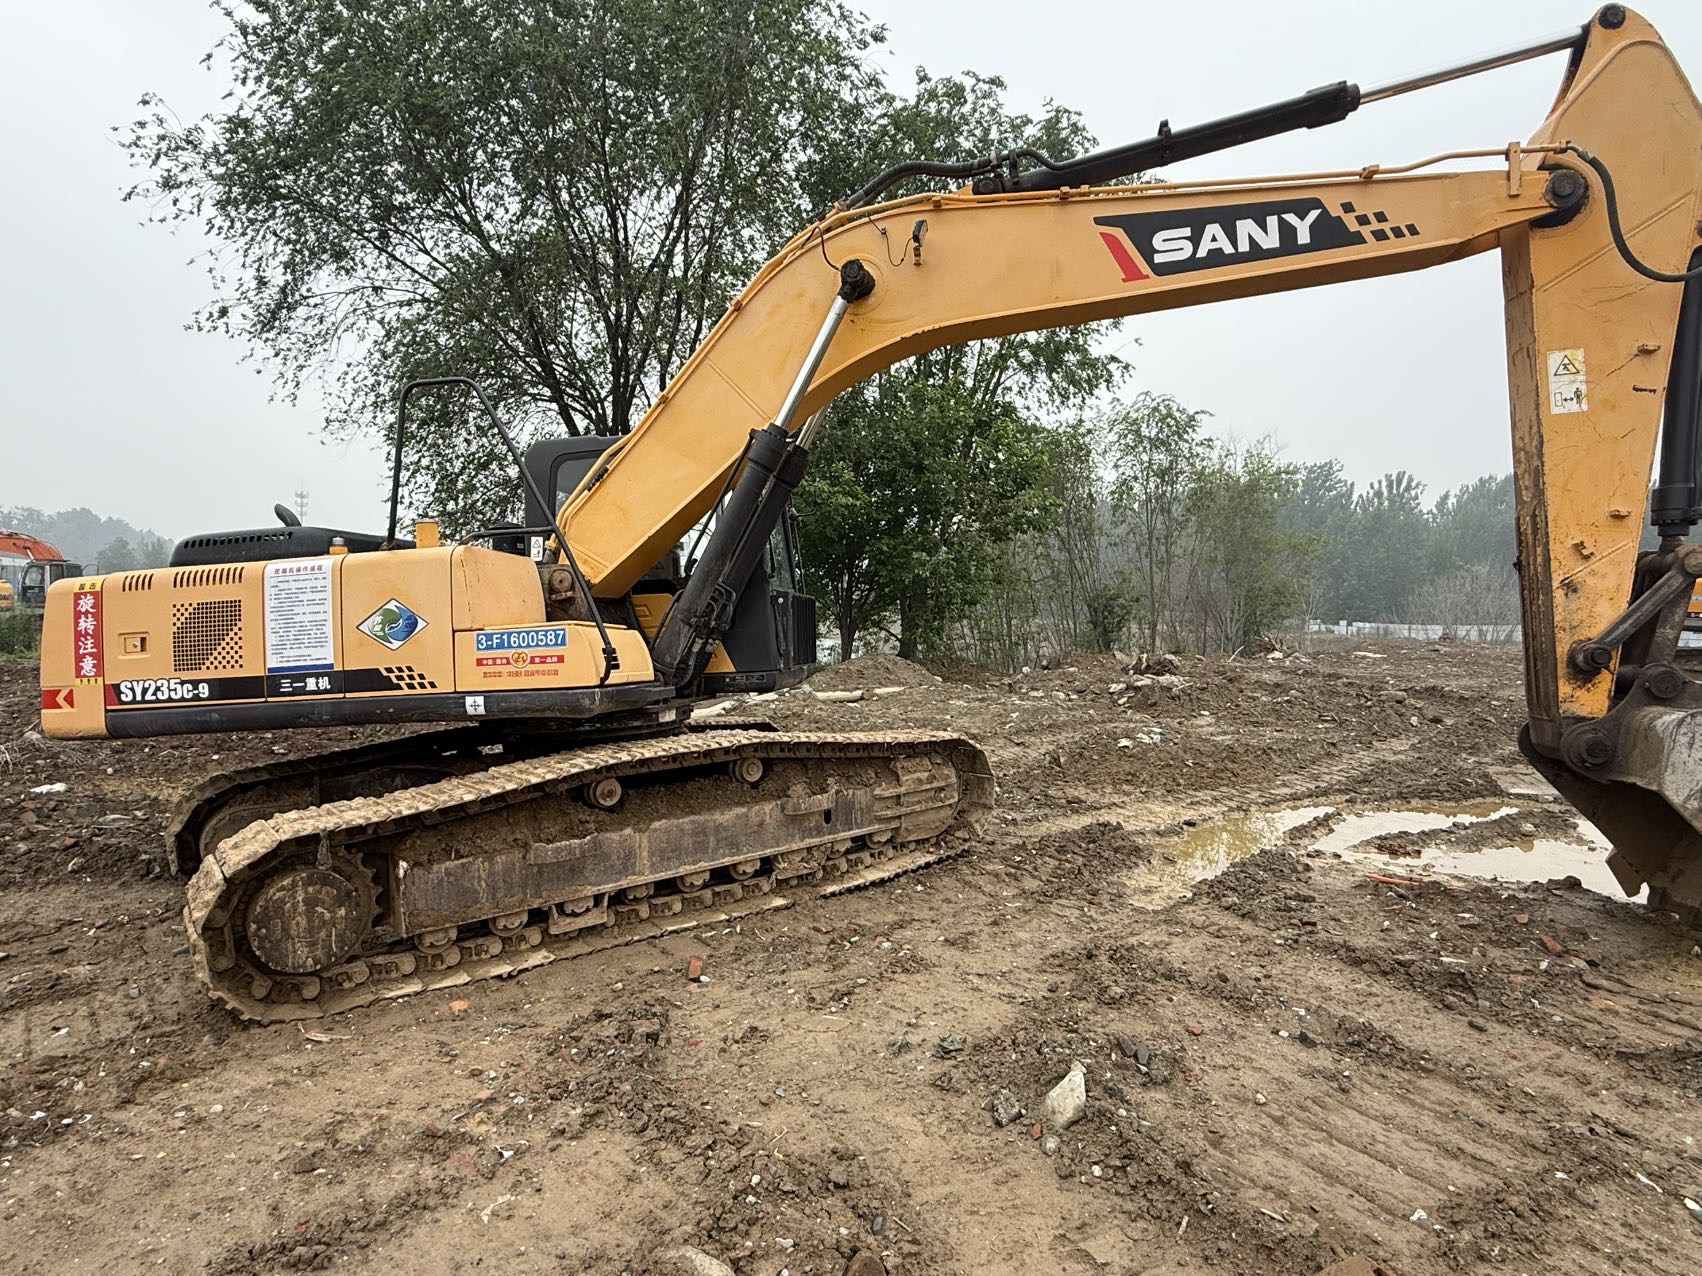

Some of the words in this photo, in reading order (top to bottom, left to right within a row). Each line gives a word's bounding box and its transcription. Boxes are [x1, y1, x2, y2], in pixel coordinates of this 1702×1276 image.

[1152, 208, 1323, 264] SANY
[76, 593, 98, 677] 旋转注意
[477, 630, 565, 649] 3-F1600587
[279, 676, 332, 692] 三一重机
